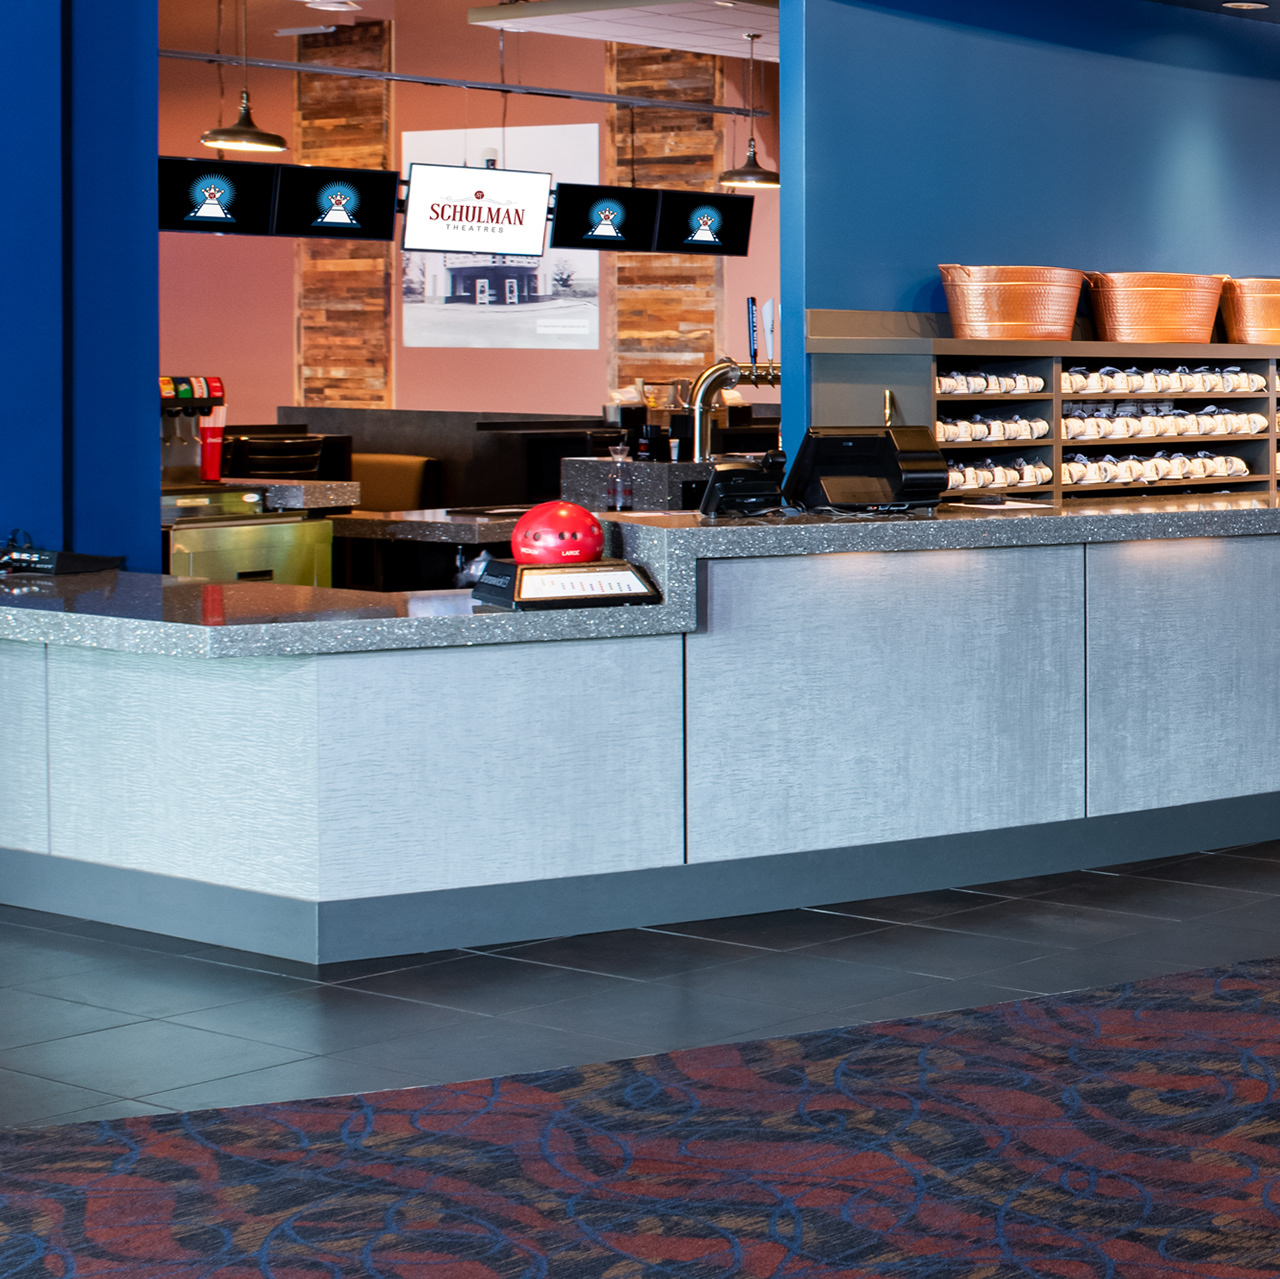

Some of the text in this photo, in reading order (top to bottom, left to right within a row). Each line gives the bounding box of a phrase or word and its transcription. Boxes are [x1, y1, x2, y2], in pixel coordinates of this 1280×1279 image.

[429, 203, 525, 226] SCHULMAN
[446, 224, 504, 233] THEATRES
[562, 549, 580, 557] LARGE
